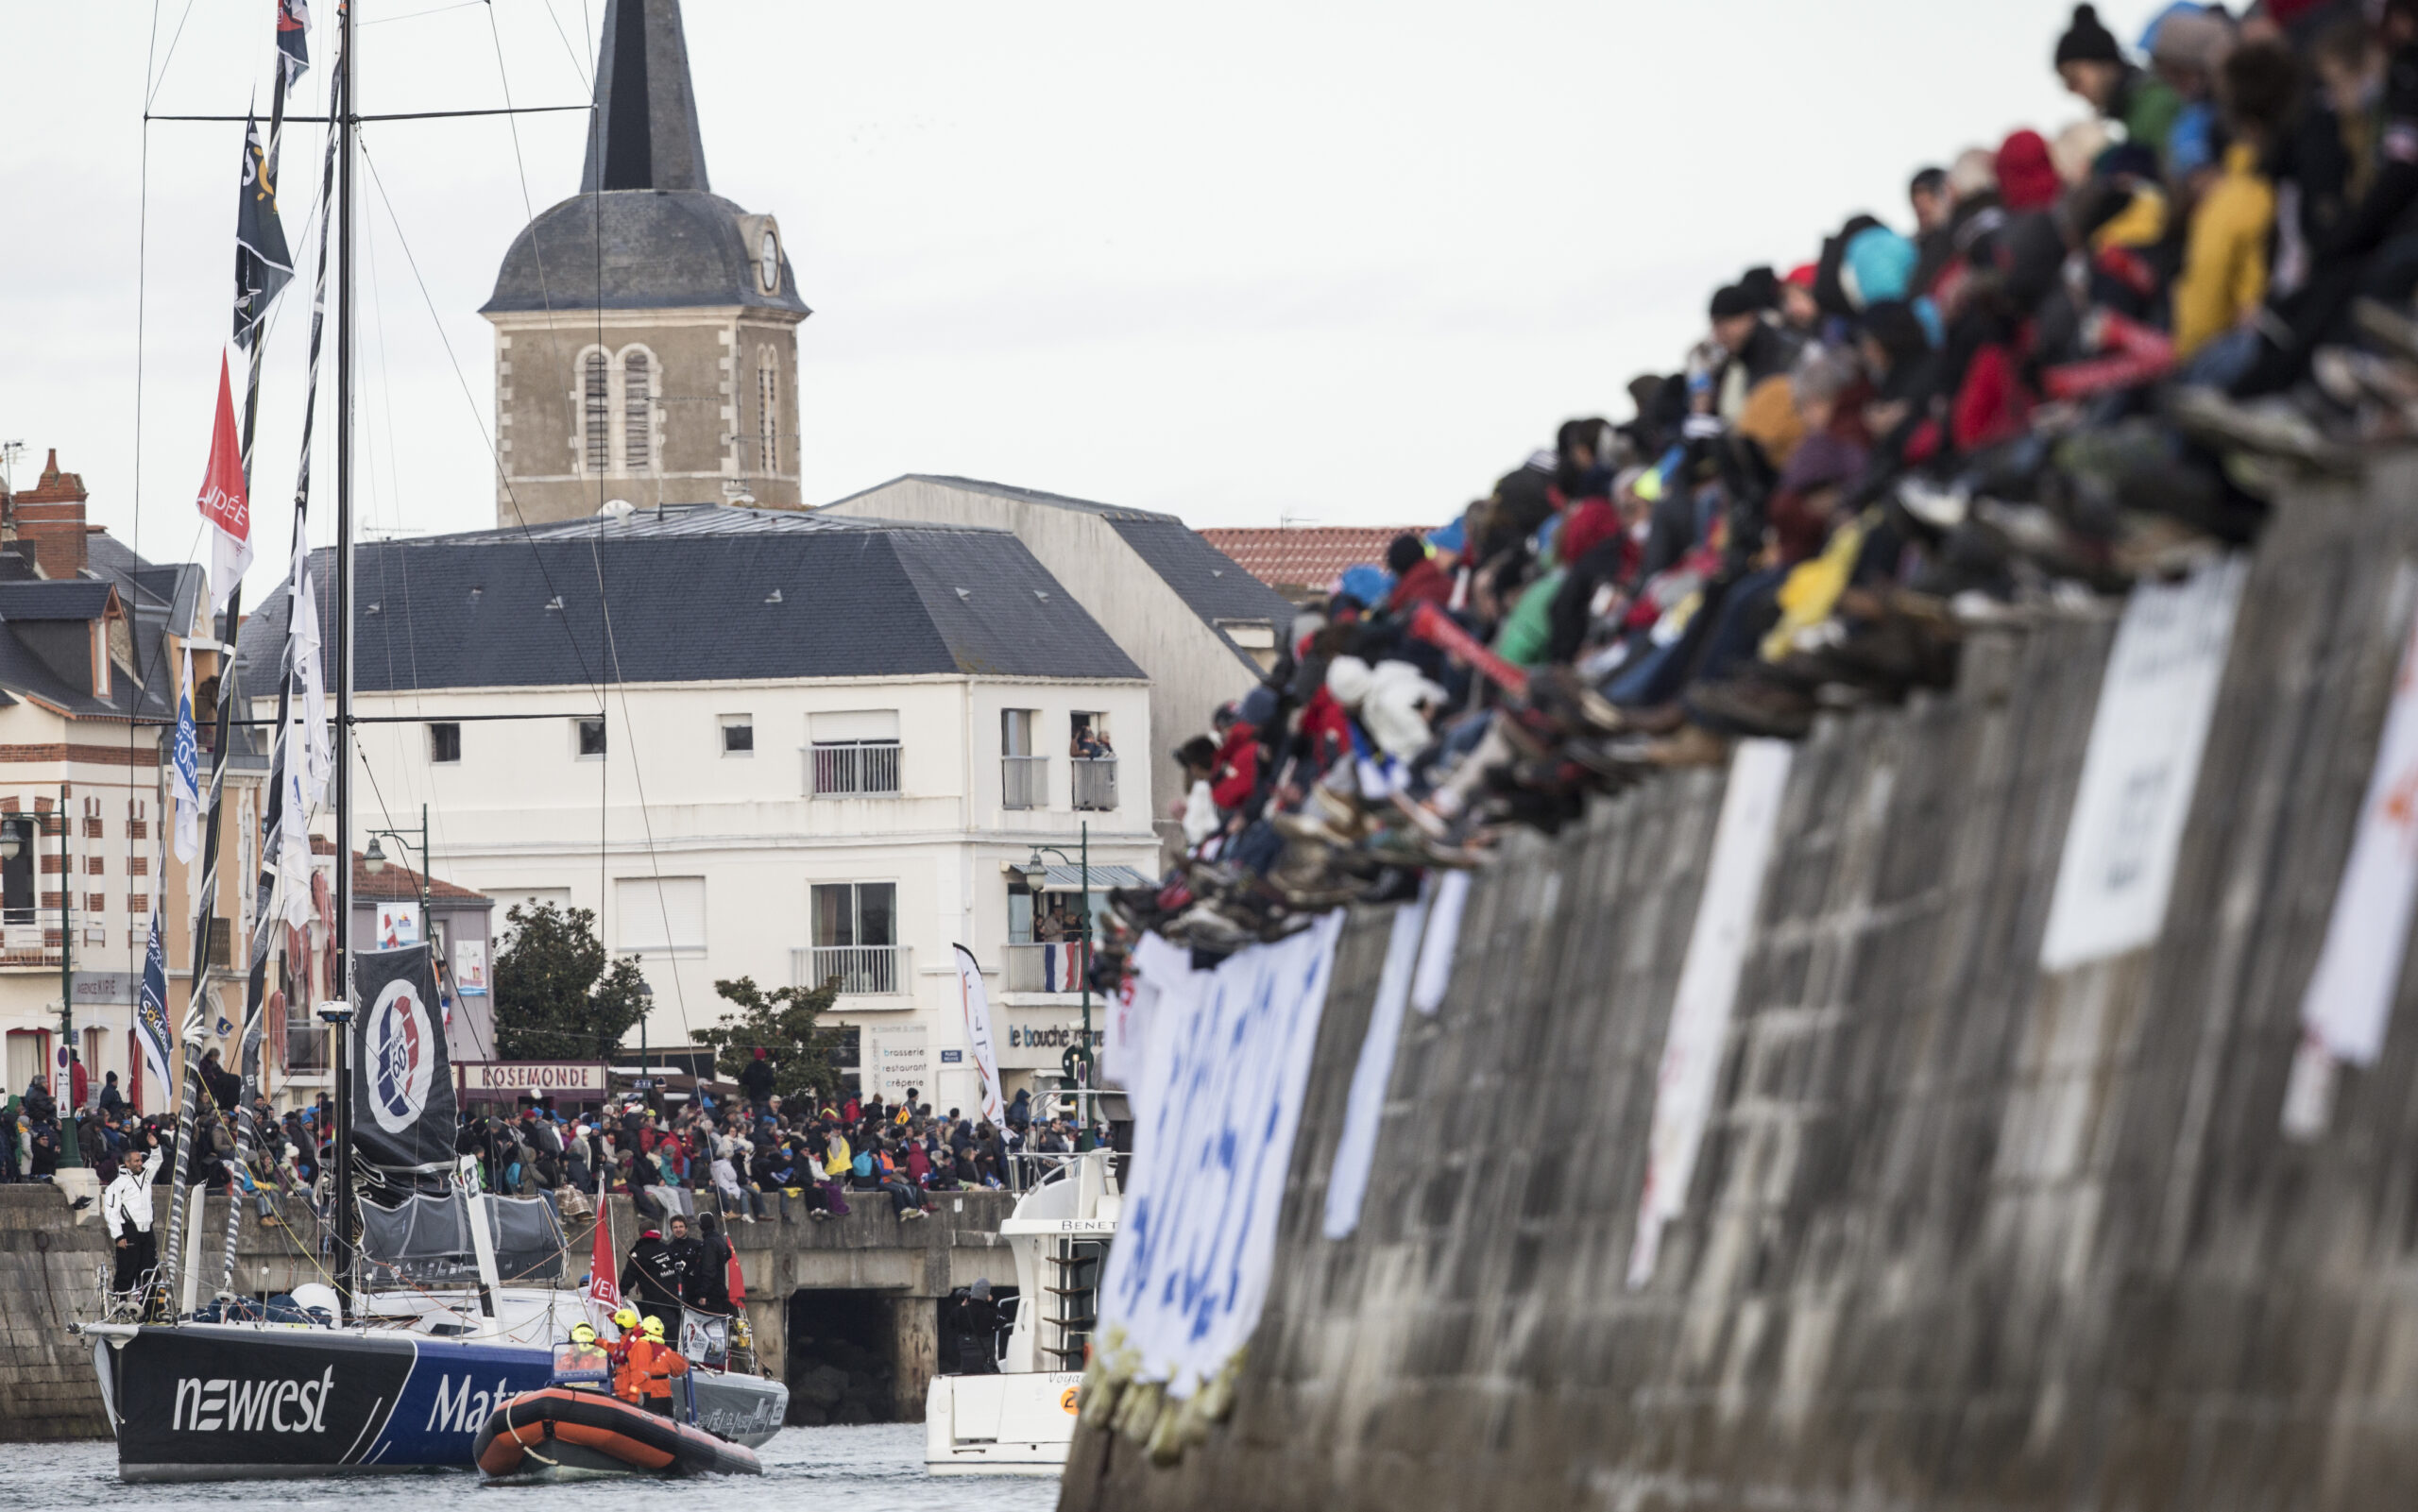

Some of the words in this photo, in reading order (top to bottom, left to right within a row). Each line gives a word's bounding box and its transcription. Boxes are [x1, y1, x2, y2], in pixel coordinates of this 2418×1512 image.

[1009, 1025, 1021, 1047] le
[1023, 1025, 1069, 1047] bouche
[392, 1045, 407, 1079] 60
[884, 1047, 925, 1057] brasserie
[483, 1067, 588, 1087] ROSEMONDE
[882, 1062, 927, 1073] restaurant
[885, 1079, 924, 1088] crêperie
[172, 1364, 334, 1433] newrest
[425, 1374, 535, 1433] Mat
